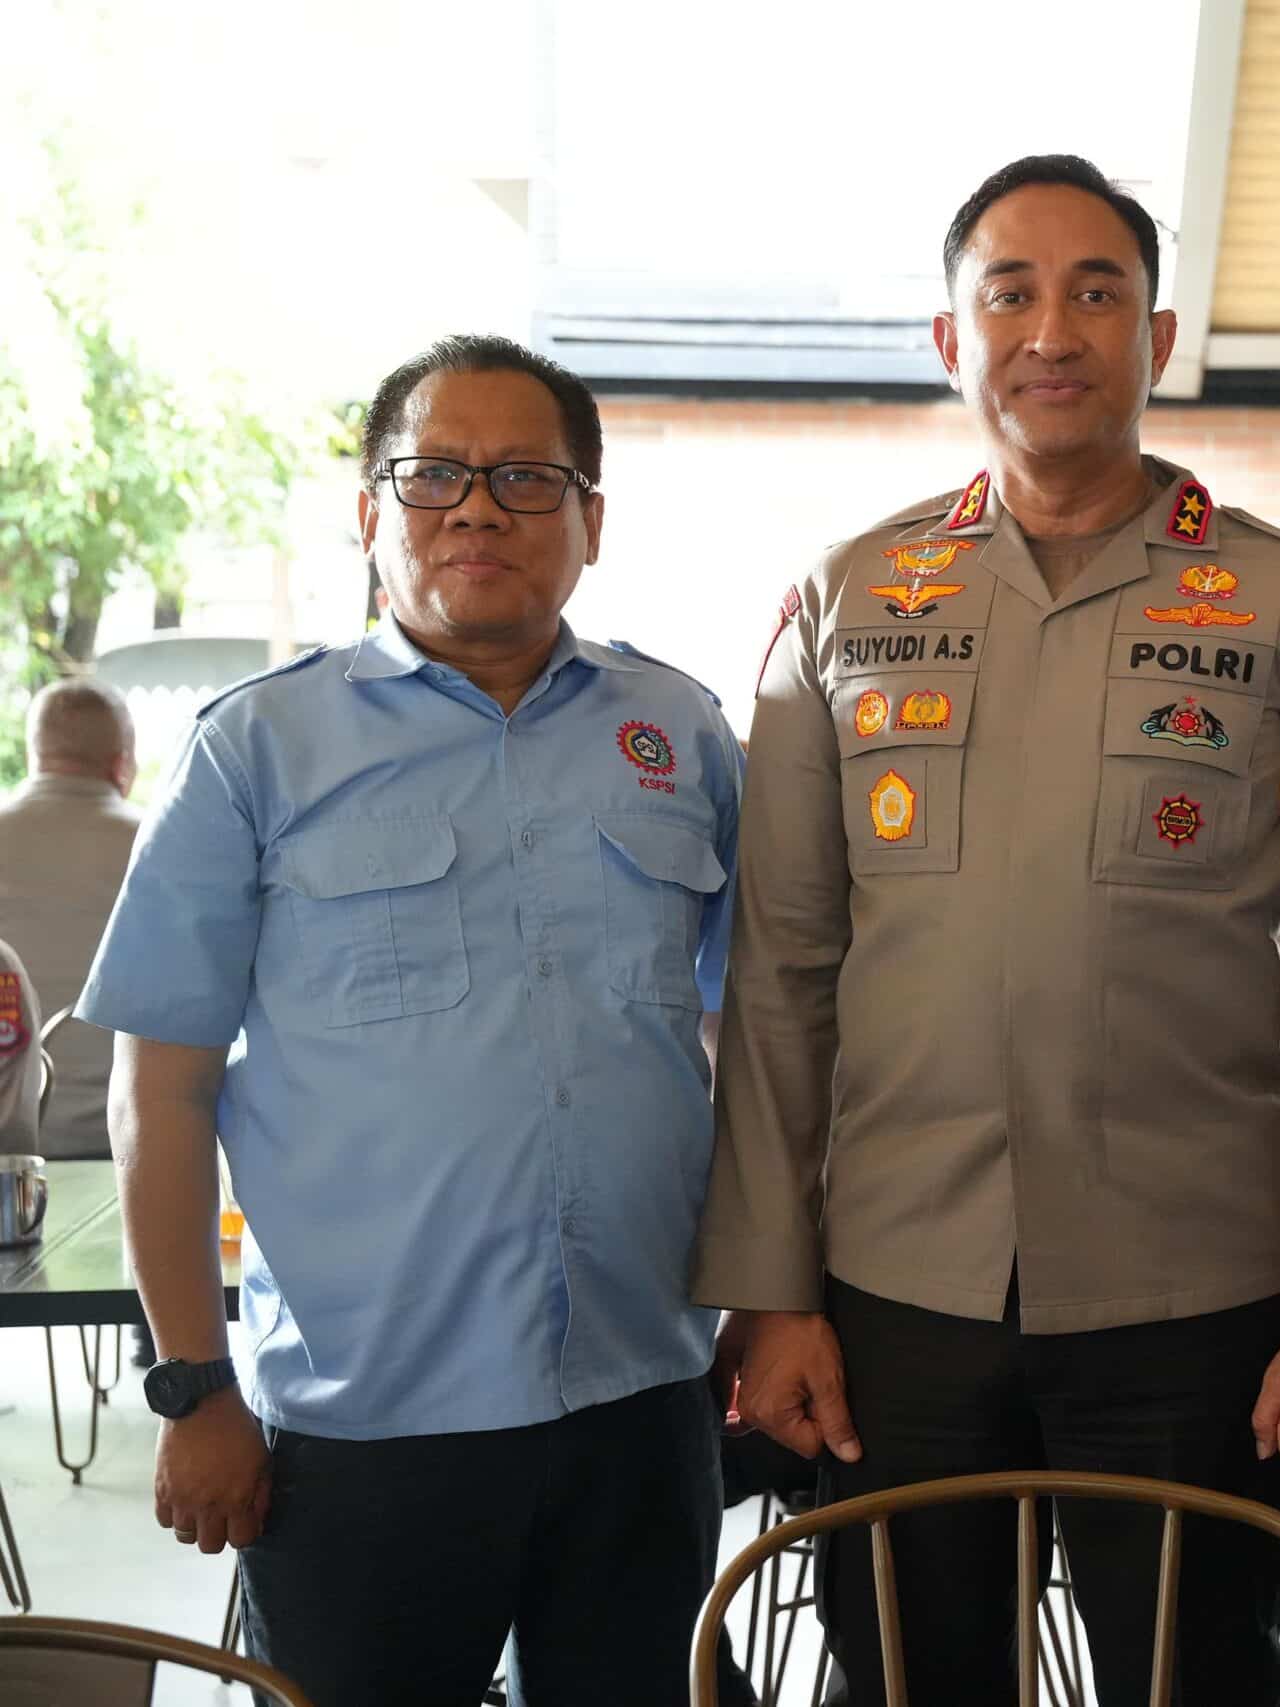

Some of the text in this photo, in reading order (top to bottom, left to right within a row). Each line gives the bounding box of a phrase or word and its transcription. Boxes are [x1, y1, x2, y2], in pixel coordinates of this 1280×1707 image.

[841, 633, 974, 668] SUYUDI A.S
[1130, 643, 1255, 683] POLRI
[639, 777, 675, 795] KSPSI
